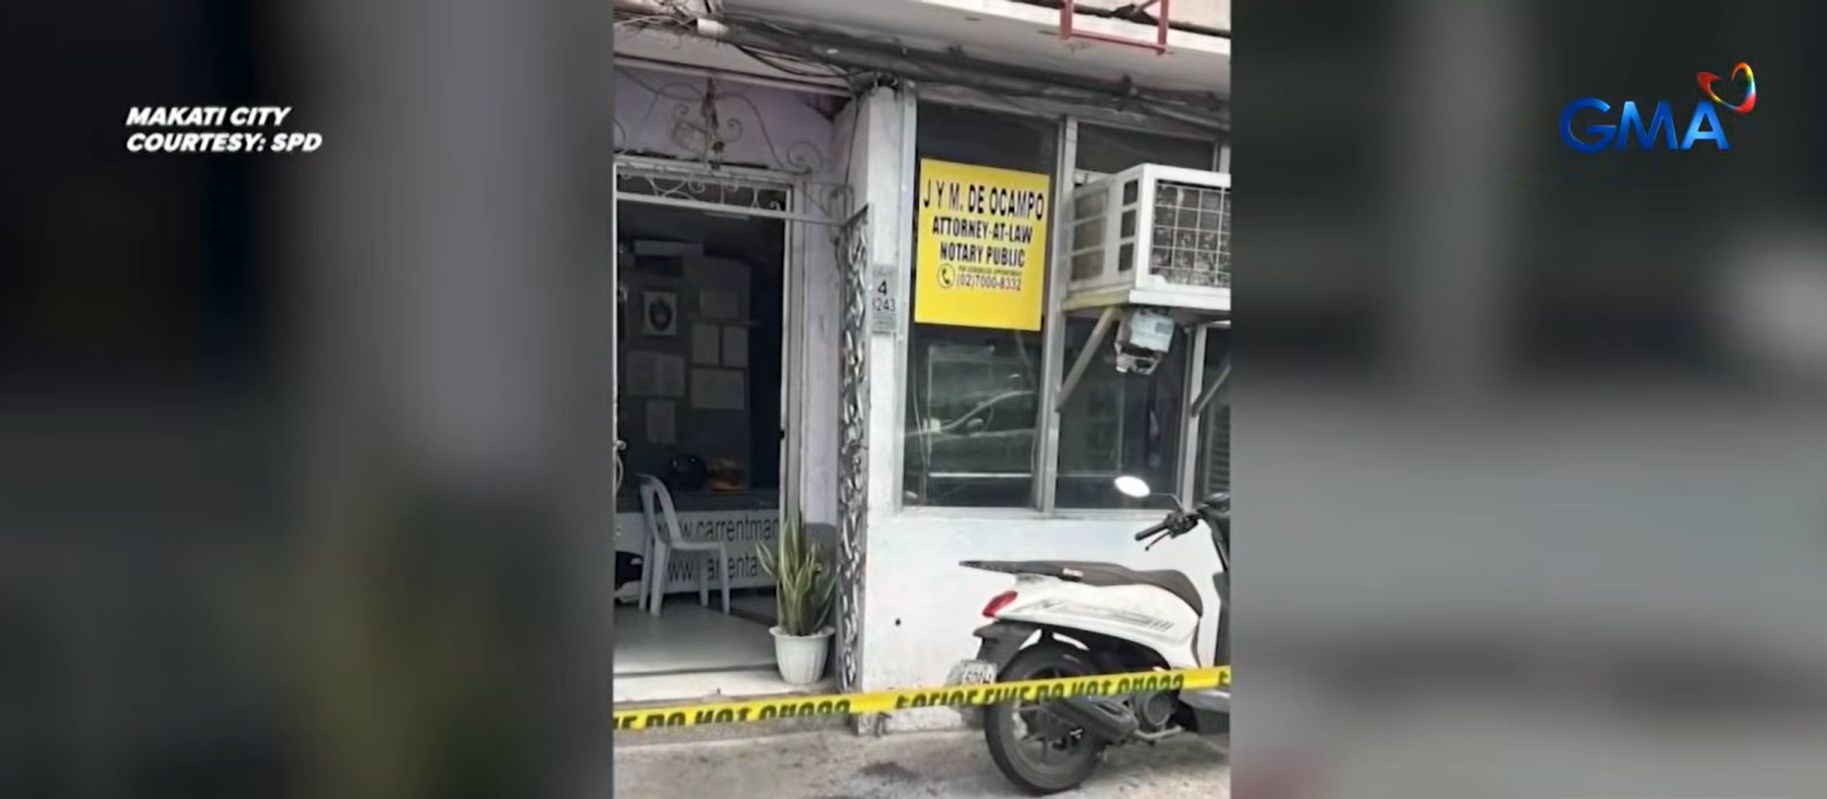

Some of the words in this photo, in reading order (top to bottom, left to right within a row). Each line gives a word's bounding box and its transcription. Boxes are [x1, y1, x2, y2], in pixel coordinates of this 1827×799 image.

[923, 179, 931, 208] J
[936, 180, 945, 209] Y
[968, 184, 985, 214] DE
[989, 187, 1044, 220] OCAMPO
[932, 215, 1033, 244] ATTORNEY-AT-LAW
[940, 241, 983, 263] NOTARY
[986, 246, 1025, 267] PUBLIC
[877, 279, 887, 296] 4
